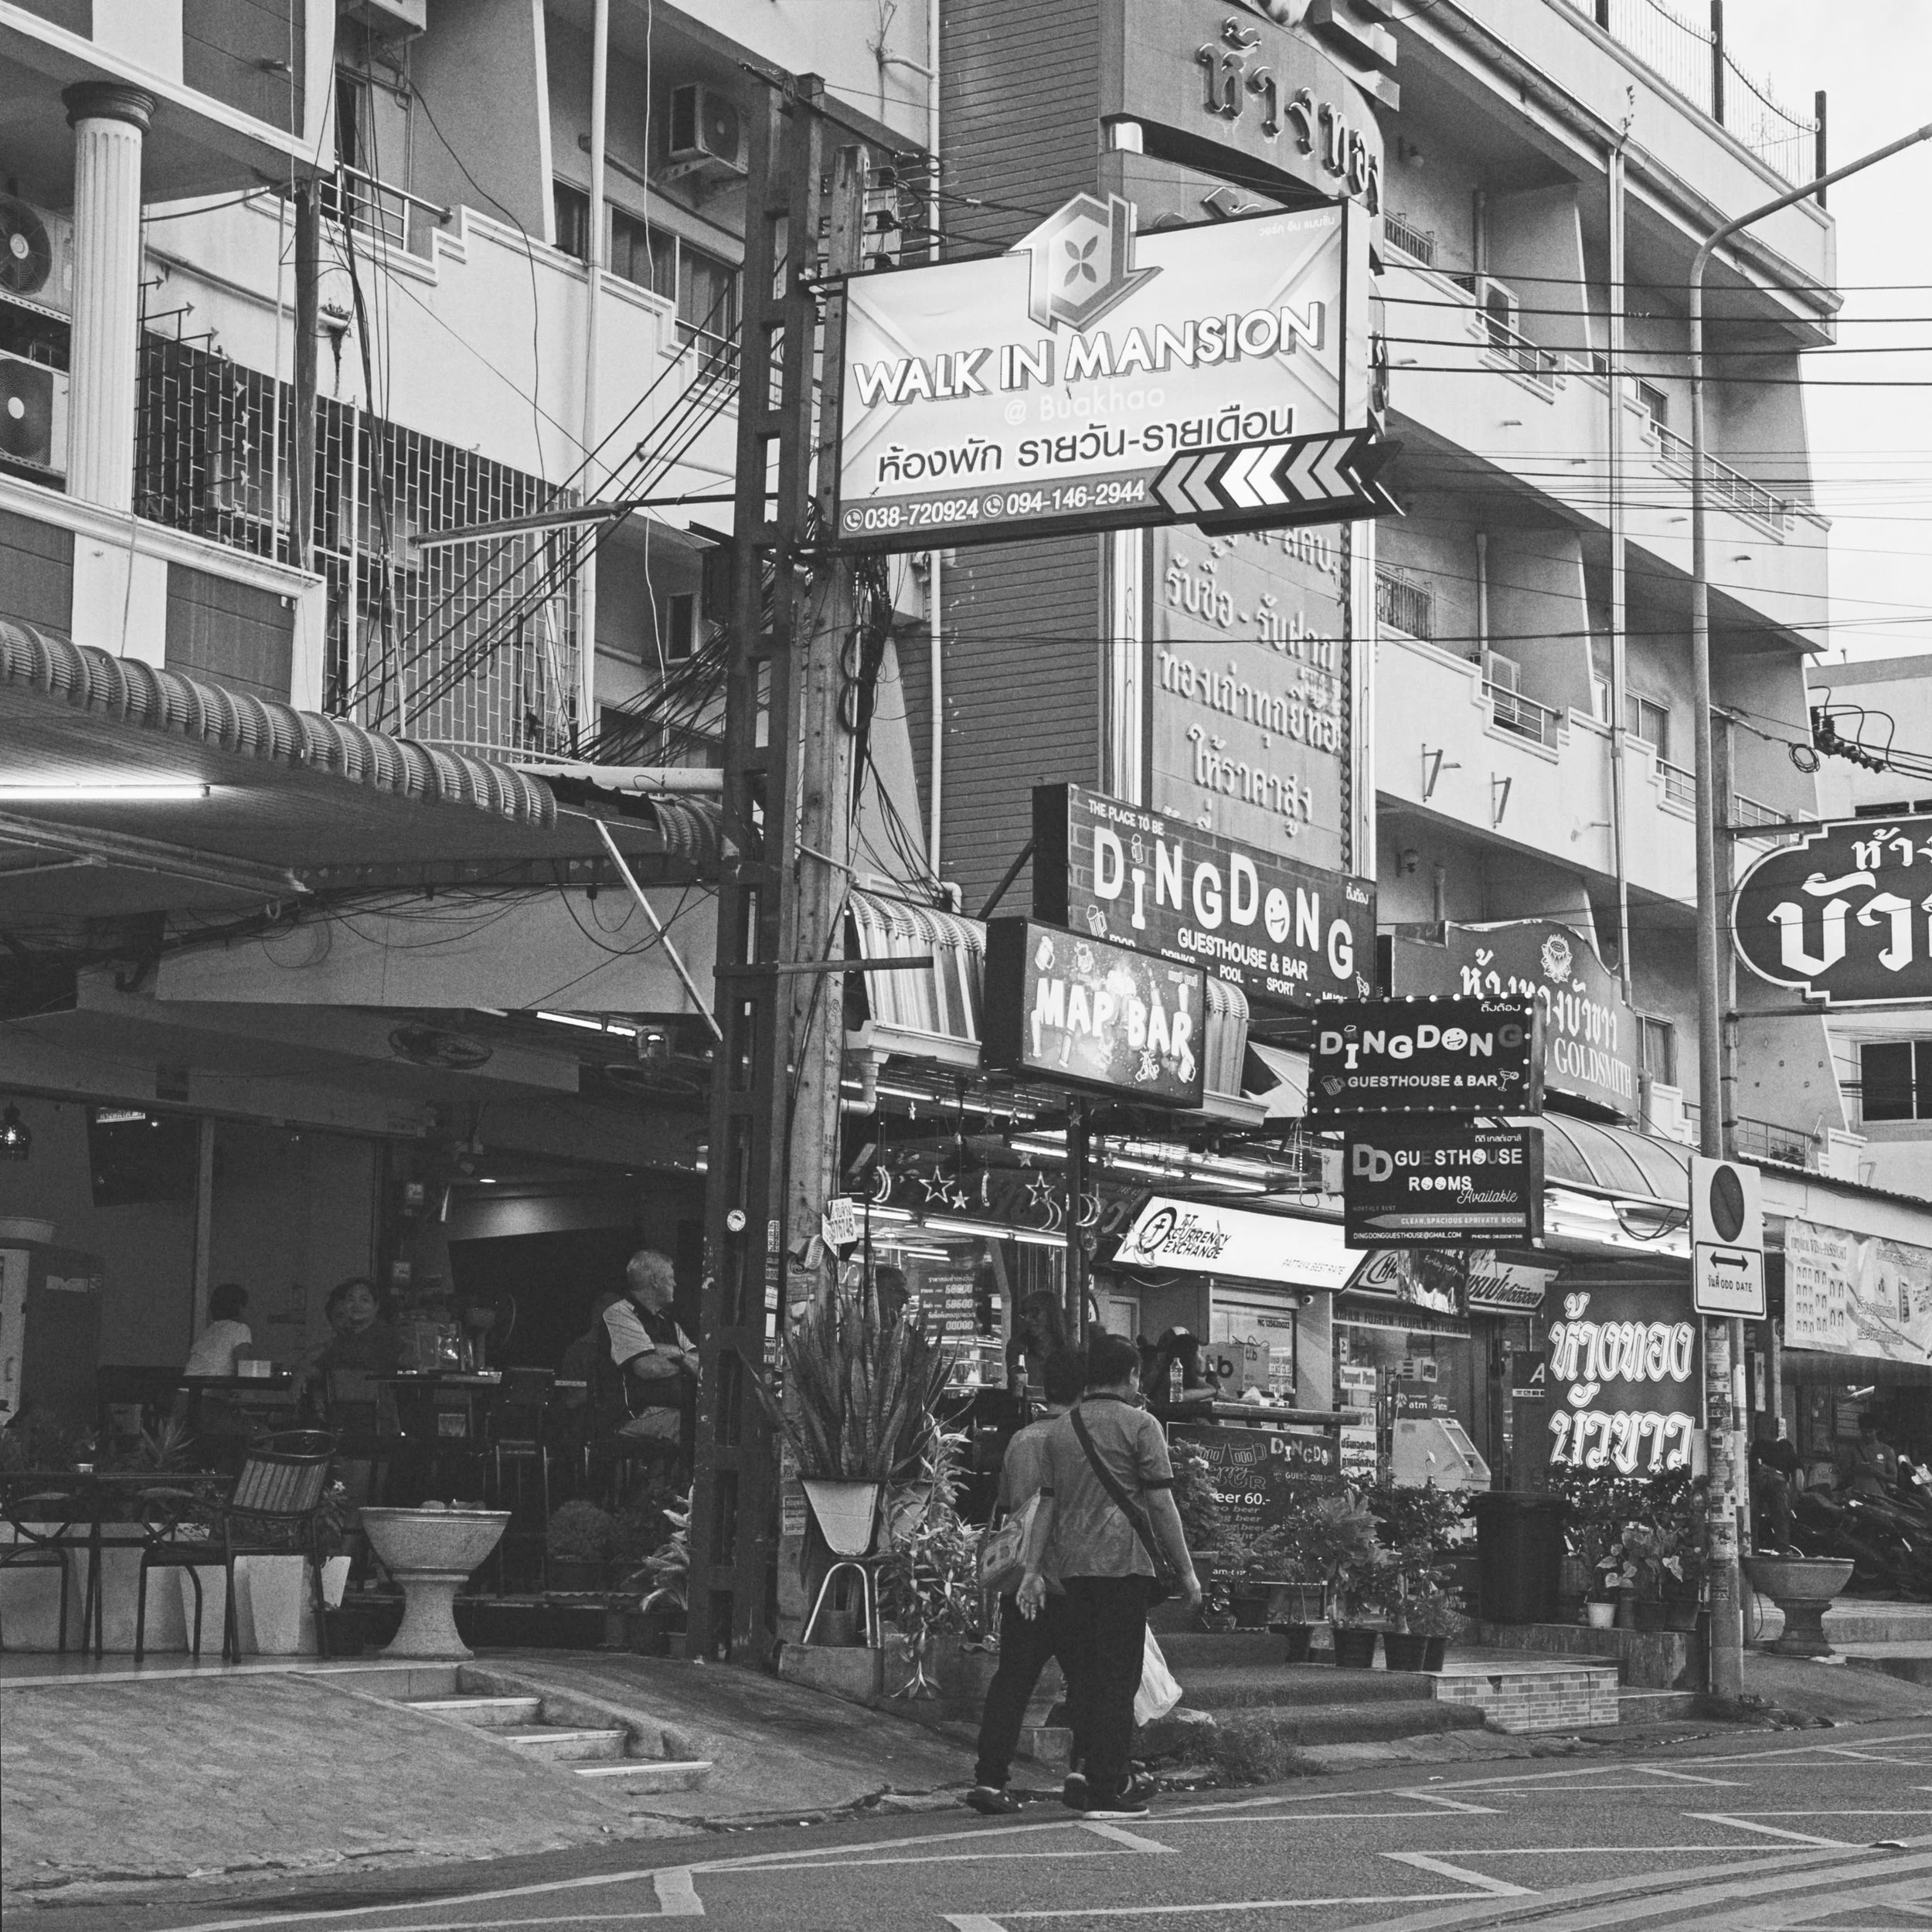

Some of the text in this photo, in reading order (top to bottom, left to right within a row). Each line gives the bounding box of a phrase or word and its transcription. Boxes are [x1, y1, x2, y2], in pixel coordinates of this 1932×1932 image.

[852, 301, 1325, 407] WALK IN MANSION
[1039, 386, 1165, 422] Buakhao
[878, 442, 1002, 484] ห้องพัก
[863, 481, 1145, 531] 038-720924 094-146-2944
[1186, 723, 1313, 837] ให้ราคาสูง
[1089, 800, 1106, 817] THE
[1107, 804, 1136, 827] PLACE
[1138, 812, 1150, 829] TO
[1151, 818, 1164, 836] BE
[1851, 827, 1932, 871] ห้า
[1767, 871, 1932, 976] บัว
[1178, 927, 1267, 971] GUESTHOUSE
[1282, 956, 1308, 981] BAR
[1219, 964, 1244, 984] POOL
[1267, 977, 1294, 996] SPORT
[1036, 977, 1195, 1063] MAP BAR
[1348, 1075, 1451, 1087] GUESTHOUSE
[1467, 1075, 1498, 1087] BAR
[1554, 1038, 1633, 1099] GOLDSMITH
[1408, 1175, 1472, 1191] ROOMS
[1457, 1188, 1518, 1204] Available
[1162, 1240, 1223, 1260] EXCHANGE
[1720, 1279, 1733, 1290] ODD
[1736, 1281, 1753, 1293] DATE
[1549, 1291, 1696, 1382] ห้างทอง
[1409, 1400, 1427, 1410] atm
